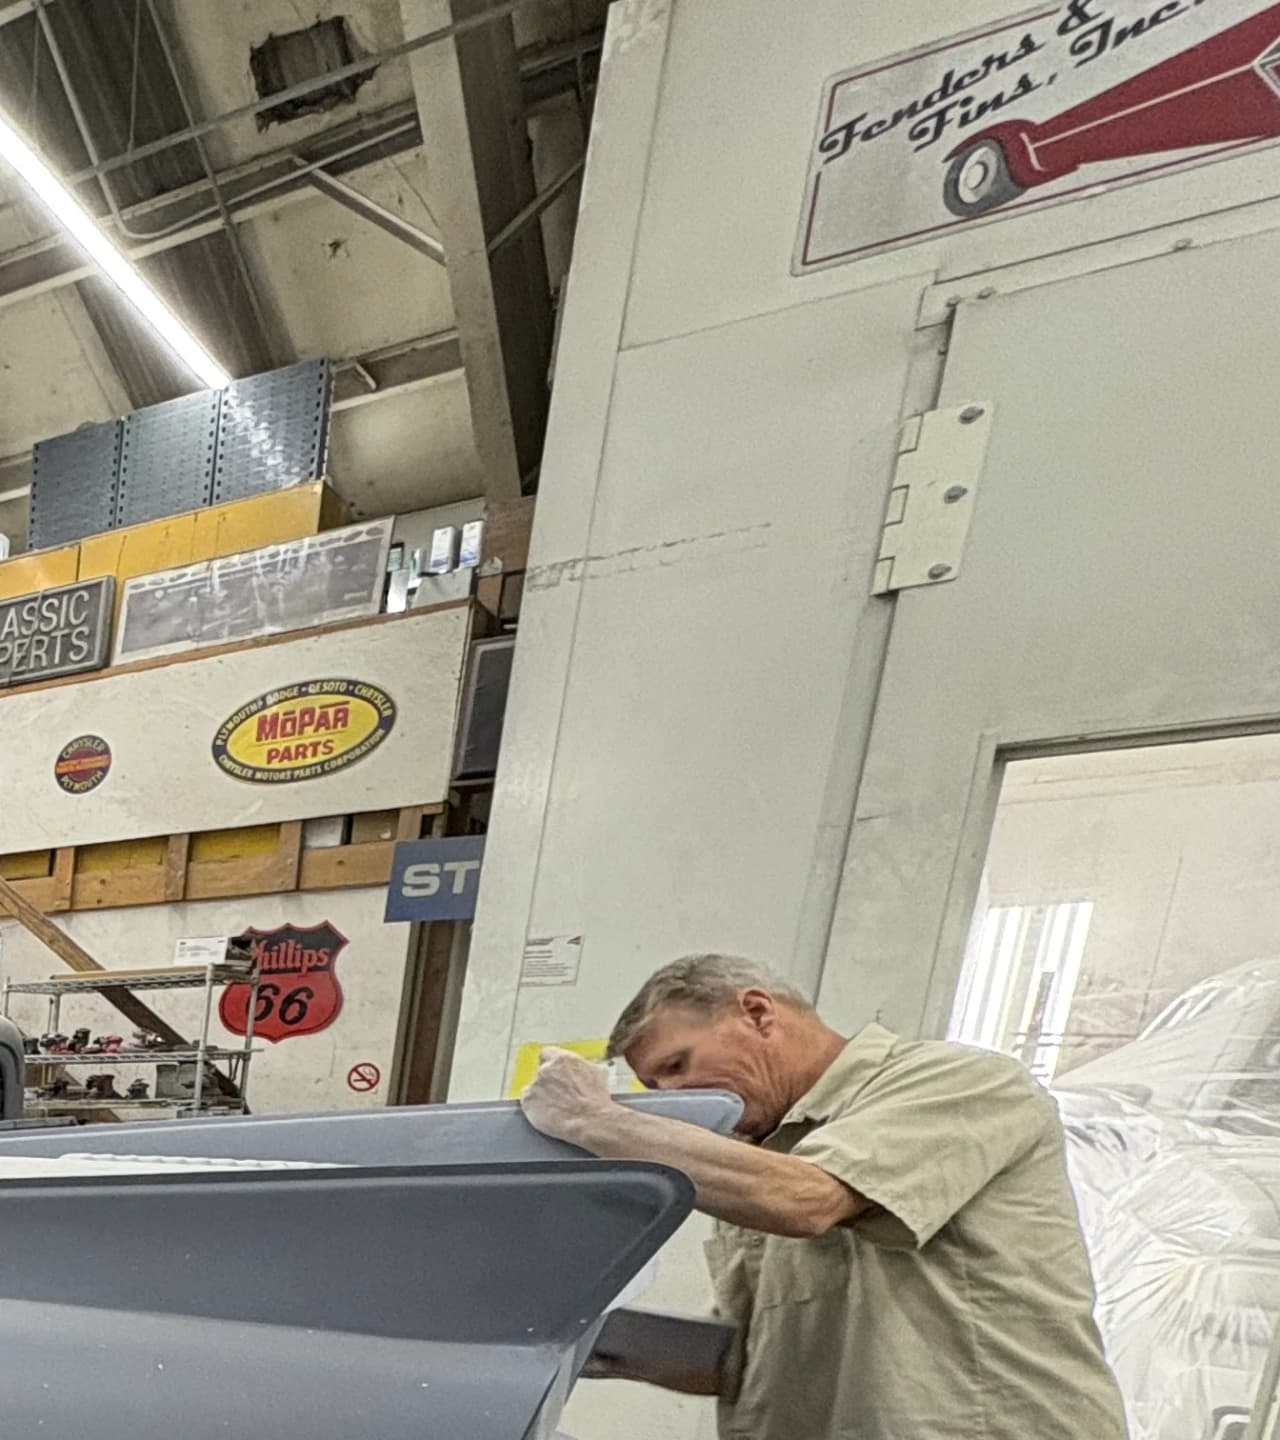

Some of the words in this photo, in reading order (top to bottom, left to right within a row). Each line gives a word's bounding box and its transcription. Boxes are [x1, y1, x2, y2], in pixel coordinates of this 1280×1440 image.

[818, 33, 1047, 166] Fenders
[1056, 0, 1105, 36] &
[908, 72, 1058, 153] Fins,
[215, 701, 260, 746] PLYMOUTH
[266, 685, 300, 707] DODGE
[354, 683, 394, 717] CHRYSLER
[255, 701, 350, 743] MOPAR
[62, 738, 106, 759] CHRYSLER
[218, 754, 254, 779] CHRYSLER
[255, 768, 292, 781] MOTORS
[293, 765, 323, 780] PARTS
[323, 728, 386, 771] CORPORATION
[265, 739, 335, 765] PARTS
[60, 770, 104, 791] PLYMOUTH
[401, 861, 480, 897] ST
[245, 984, 314, 1025] 66
